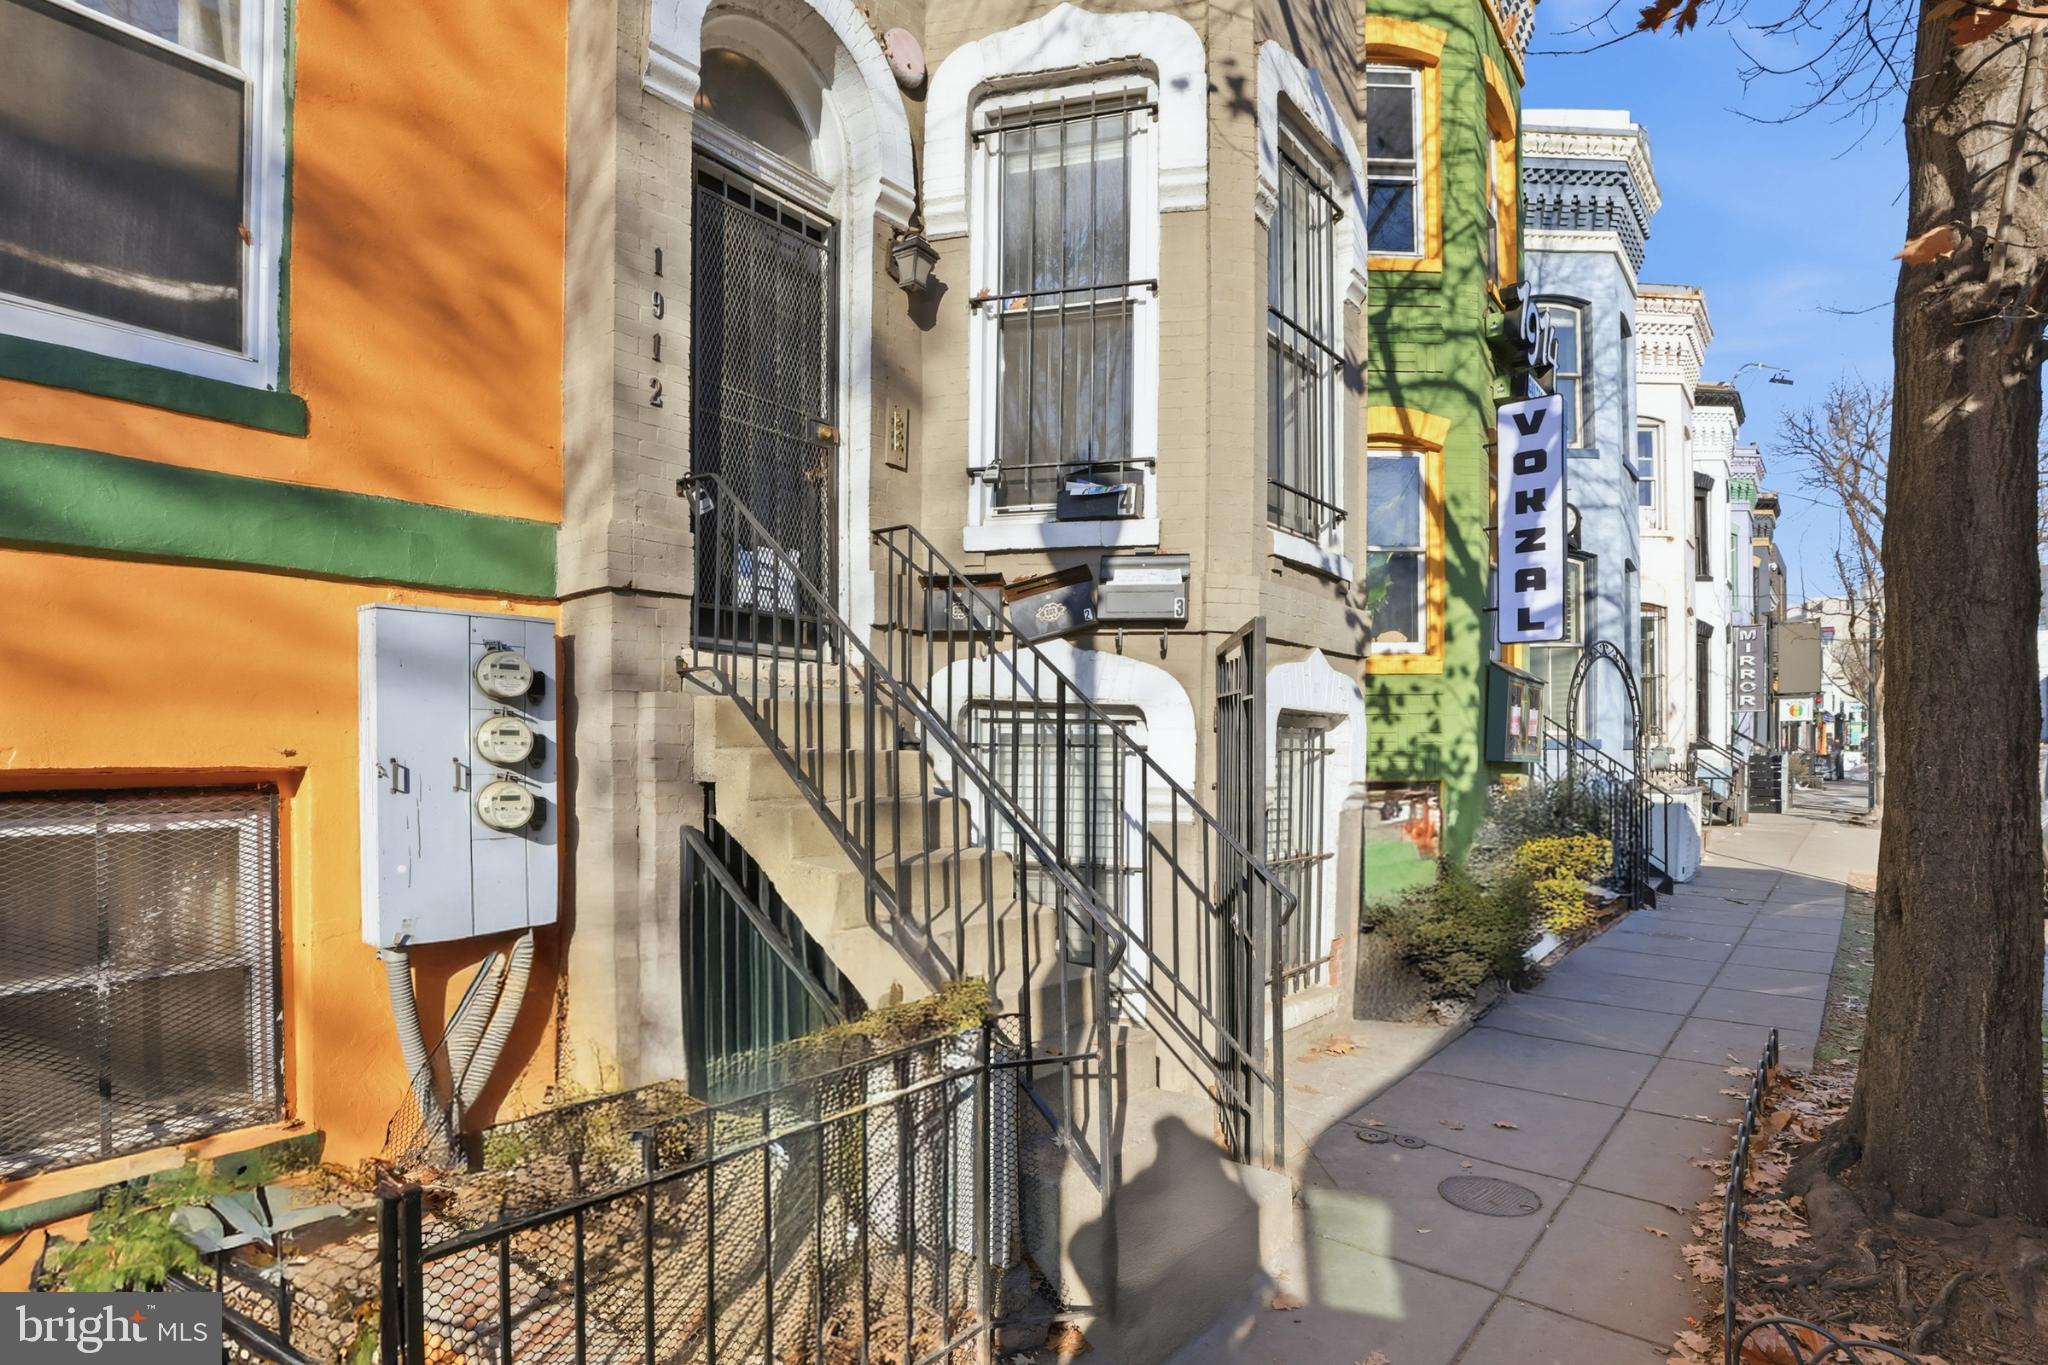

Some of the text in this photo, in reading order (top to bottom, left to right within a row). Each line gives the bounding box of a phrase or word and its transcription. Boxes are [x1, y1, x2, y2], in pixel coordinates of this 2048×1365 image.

[651, 247, 664, 408] 1912
[1517, 281, 1558, 393] 1914
[1119, 486, 1132, 513] 4
[1513, 409, 1547, 631] VOKZAL
[1175, 599, 1184, 617] 3
[1740, 629, 1757, 706] MIRROR
